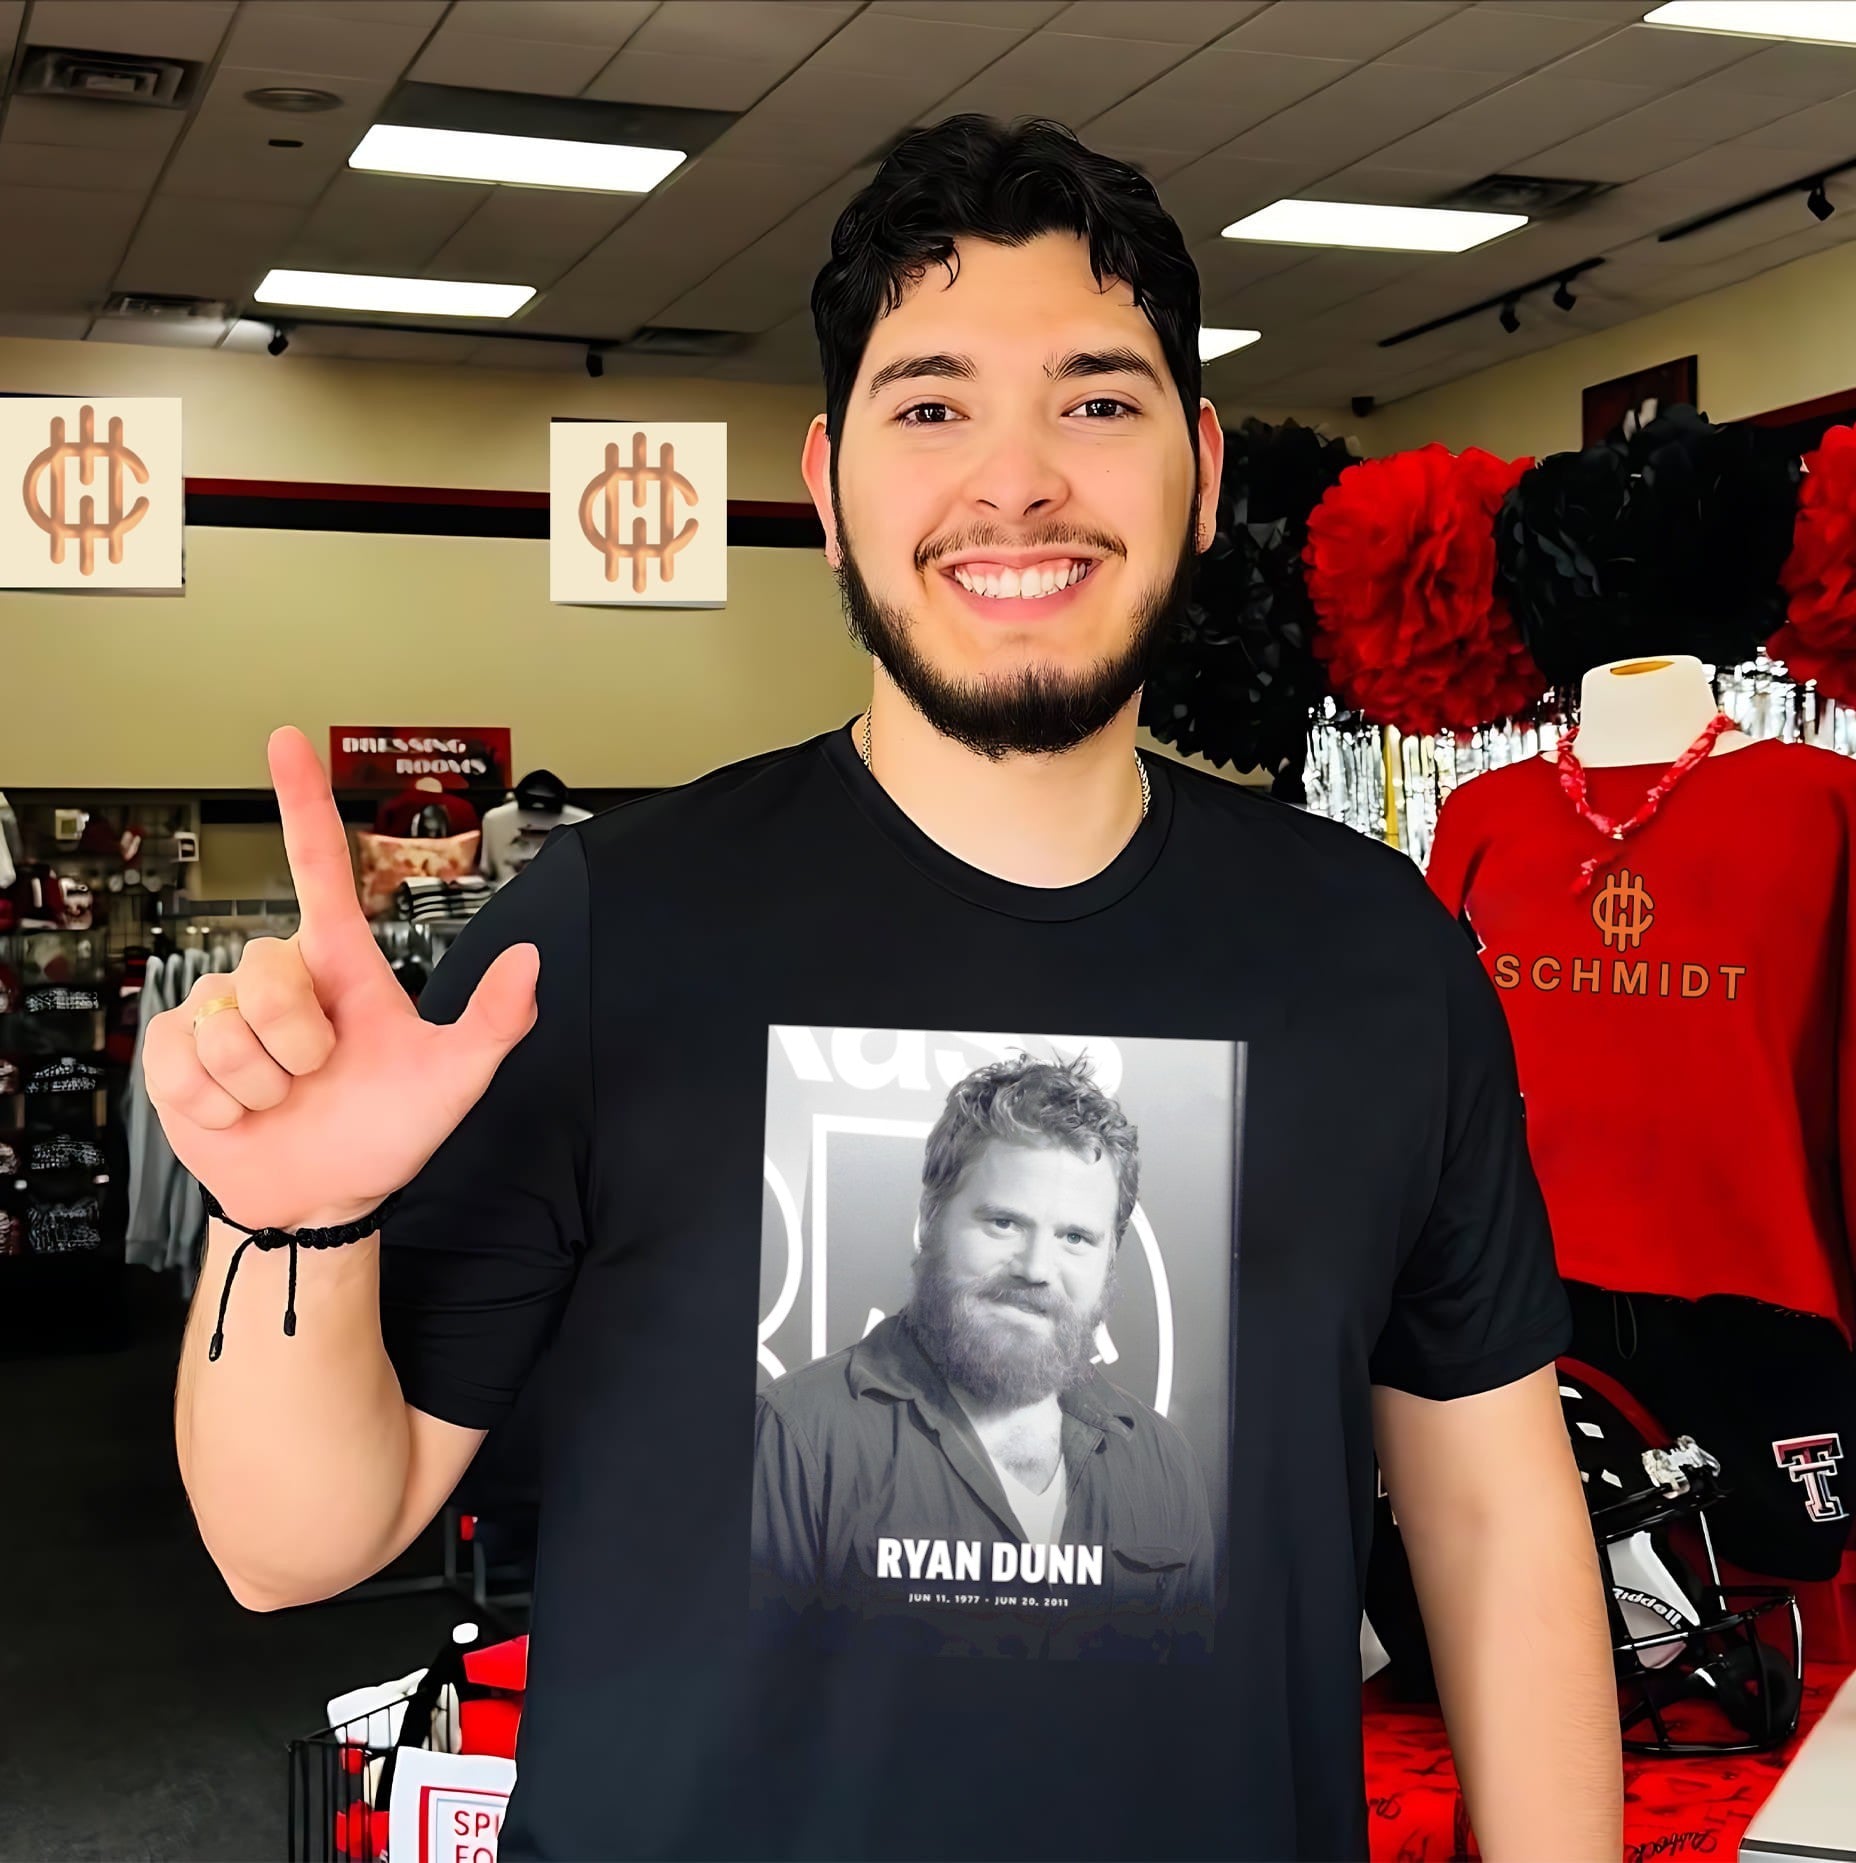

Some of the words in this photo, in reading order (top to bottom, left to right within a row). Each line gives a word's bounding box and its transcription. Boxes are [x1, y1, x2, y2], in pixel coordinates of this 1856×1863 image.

[1494, 954, 1746, 1000] SCHMIDT
[876, 1537, 982, 1582] RYAN
[991, 1541, 1103, 1586] DUNN
[908, 1593, 931, 1603] JUN
[955, 1595, 980, 1604] 1977
[994, 1596, 1017, 1605] JUN
[1044, 1598, 1069, 1607] 2011
